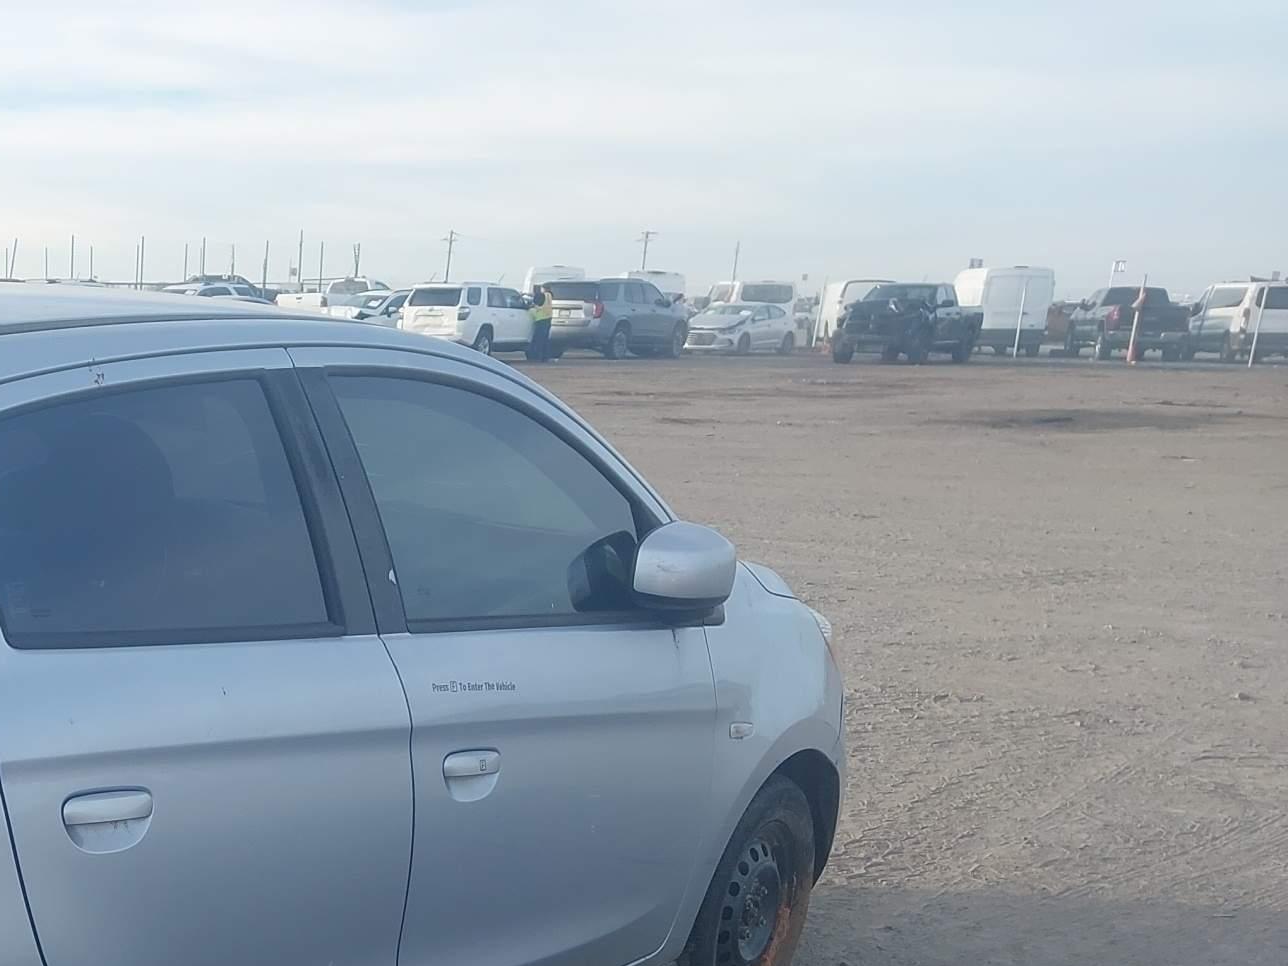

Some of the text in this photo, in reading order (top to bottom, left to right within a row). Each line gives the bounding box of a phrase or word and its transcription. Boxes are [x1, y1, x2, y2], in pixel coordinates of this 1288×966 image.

[432, 683, 450, 693] Press
[458, 682, 467, 692] To
[467, 682, 484, 692] Enter
[484, 681, 495, 691] The
[495, 681, 516, 691] Vehicle
